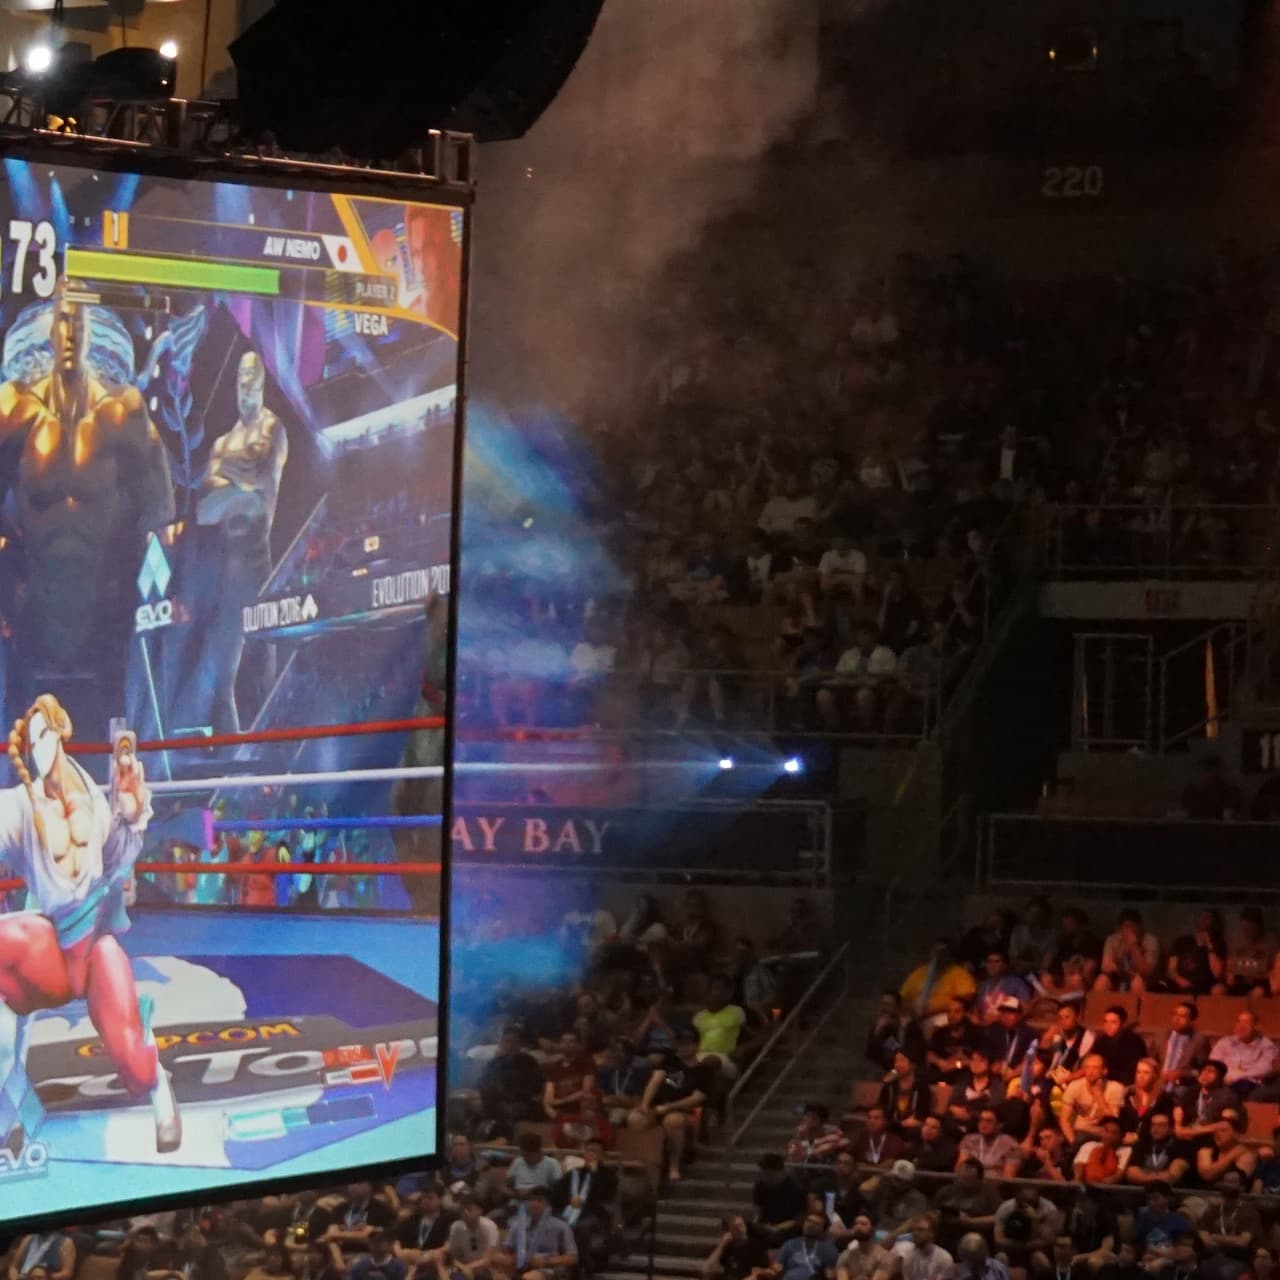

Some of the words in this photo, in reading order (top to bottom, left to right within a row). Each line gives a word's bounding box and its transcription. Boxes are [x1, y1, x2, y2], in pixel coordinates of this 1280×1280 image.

[1042, 165, 1103, 197] 220
[9, 220, 57, 298] 73
[263, 236, 284, 257] AW
[284, 239, 321, 261] NEMO
[354, 312, 389, 336] VEGA
[372, 567, 429, 608] EVOLUTION
[136, 600, 173, 628] EVO
[280, 595, 301, 626] 2016
[524, 817, 610, 854] BAY
[78, 1022, 301, 1057] CPCOM
